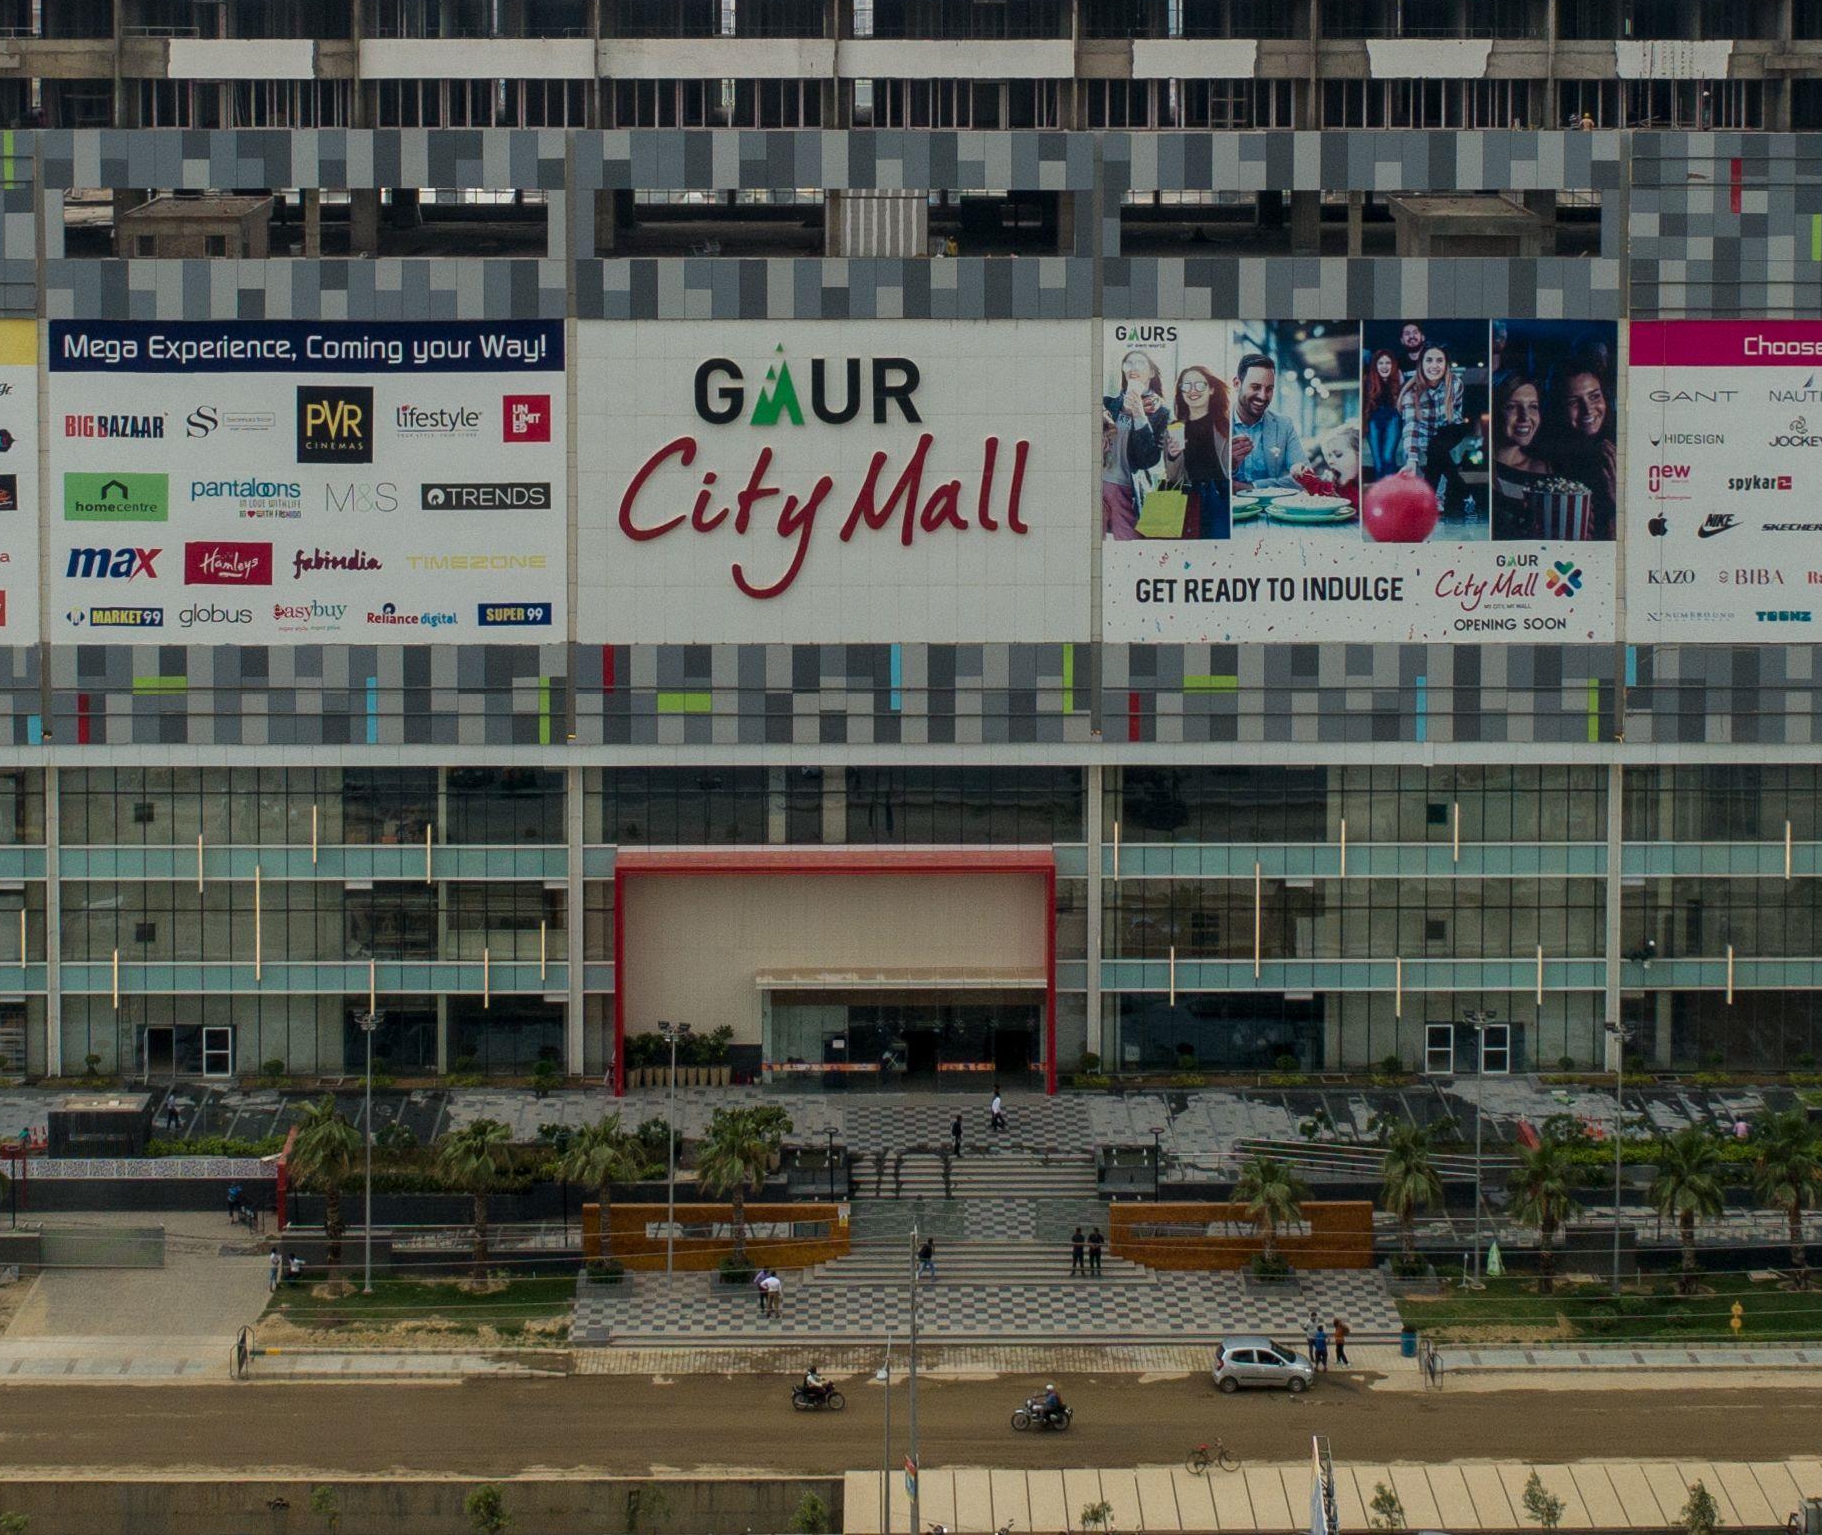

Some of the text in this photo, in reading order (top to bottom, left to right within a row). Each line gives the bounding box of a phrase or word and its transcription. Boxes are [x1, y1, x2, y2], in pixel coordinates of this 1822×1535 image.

[1115, 324, 1177, 342] GAURS
[64, 333, 547, 364] Mega Experience, Coming your Way!
[694, 343, 923, 426] GAUR
[1649, 390, 1738, 403] GANT
[512, 404, 528, 414] UN
[306, 400, 363, 441] PVR
[396, 404, 479, 431] lifestyle
[512, 413, 542, 424] LIMIT
[65, 414, 165, 439] BIG BAZAAR
[305, 441, 364, 451] CINEMAS
[1664, 434, 1725, 445] HIDESIGN
[1649, 465, 1691, 478] new
[191, 478, 301, 501] pantaloons
[1728, 475, 1777, 491] spykar
[326, 481, 398, 513] M&S
[446, 487, 546, 506] TRENDS
[75, 502, 158, 513] homecentre
[618, 433, 1030, 600] City Mall
[1704, 514, 1735, 527] NIKE
[66, 547, 164, 583] max
[200, 547, 259, 579] Hamleys
[293, 548, 383, 579] fabindia
[406, 554, 547, 569] TIMEZONE
[1496, 553, 1539, 567] GAUR
[1647, 570, 1695, 584] KAZO
[1736, 570, 1785, 585] BIBA
[1136, 576, 1403, 603] GET READY TO INDULGE
[1435, 569, 1539, 611] City Mall
[91, 609, 162, 625] MARKET 99
[179, 603, 253, 628] globus
[367, 612, 458, 627] Reliance digital
[486, 607, 544, 621] SUPER 99
[1756, 611, 1812, 622] TOONZ
[1454, 617, 1567, 631] OPENING SOON
